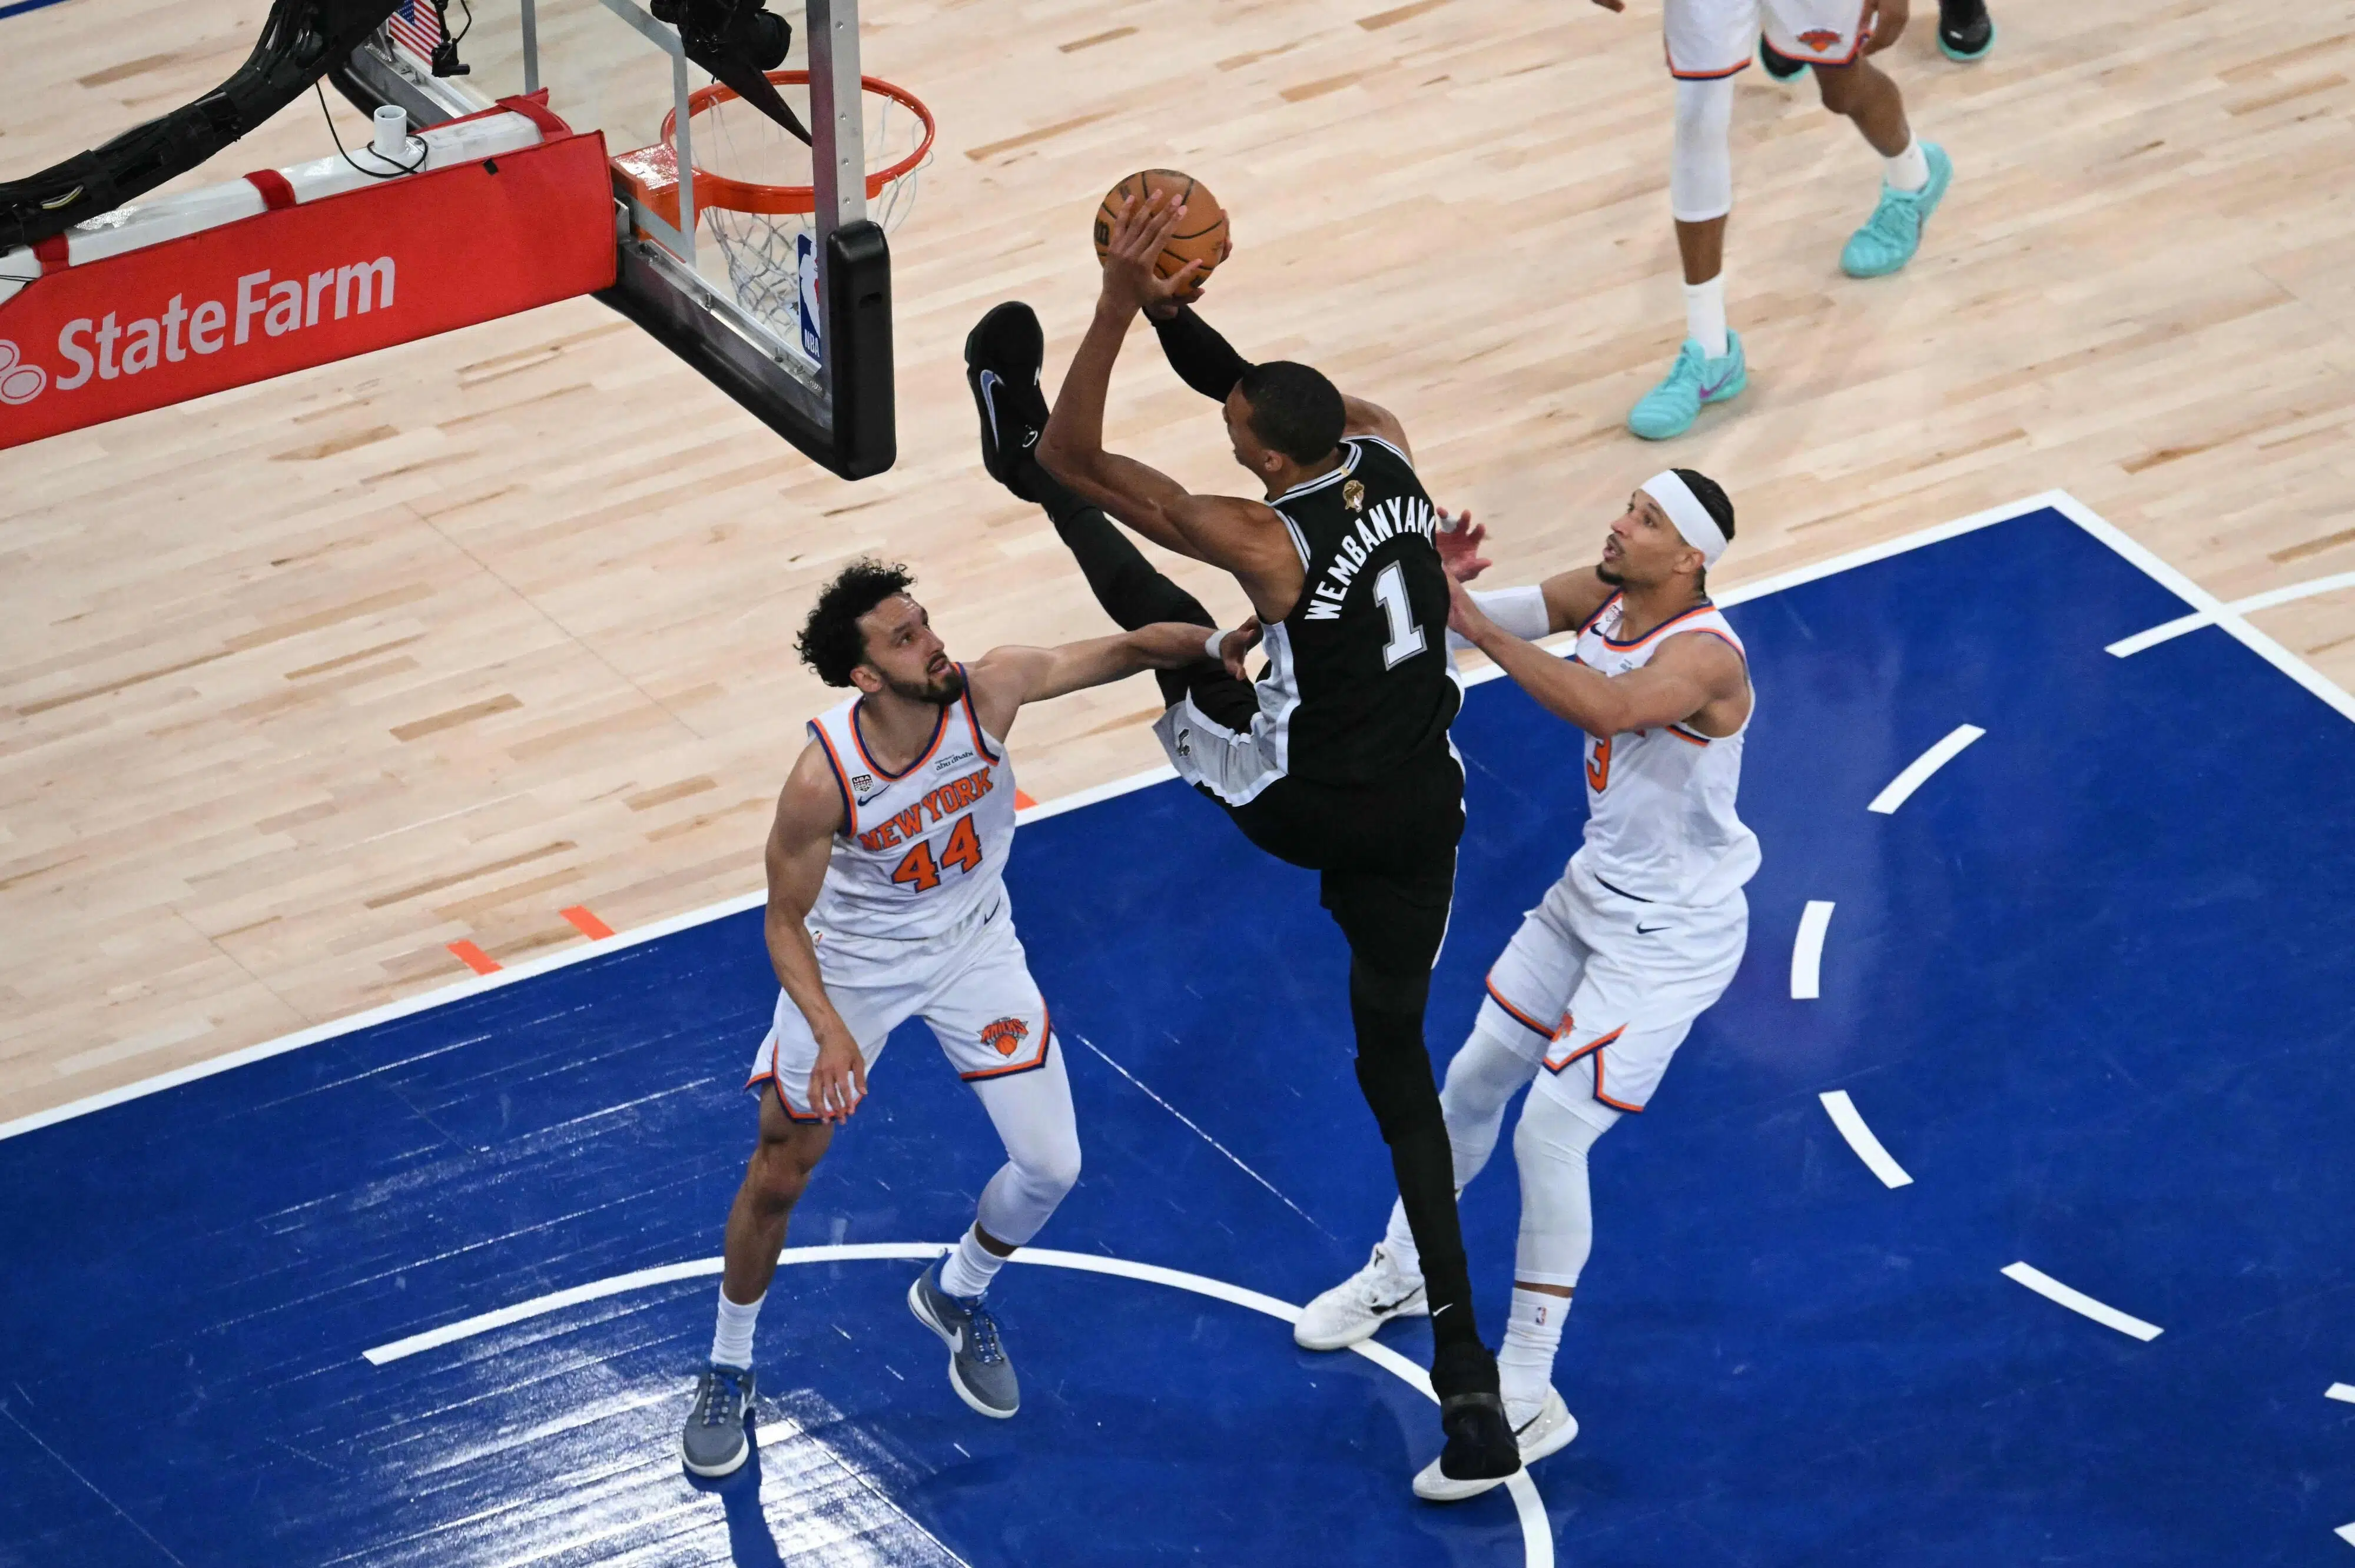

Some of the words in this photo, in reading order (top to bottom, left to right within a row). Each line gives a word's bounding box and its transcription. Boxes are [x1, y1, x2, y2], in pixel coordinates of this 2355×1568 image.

[804, 328, 820, 358] NBA
[1373, 560, 1428, 671] 1
[936, 762, 951, 771] abu
[951, 751, 974, 764] dhabi
[1587, 737, 1612, 794] 3
[891, 812, 983, 893] 44
